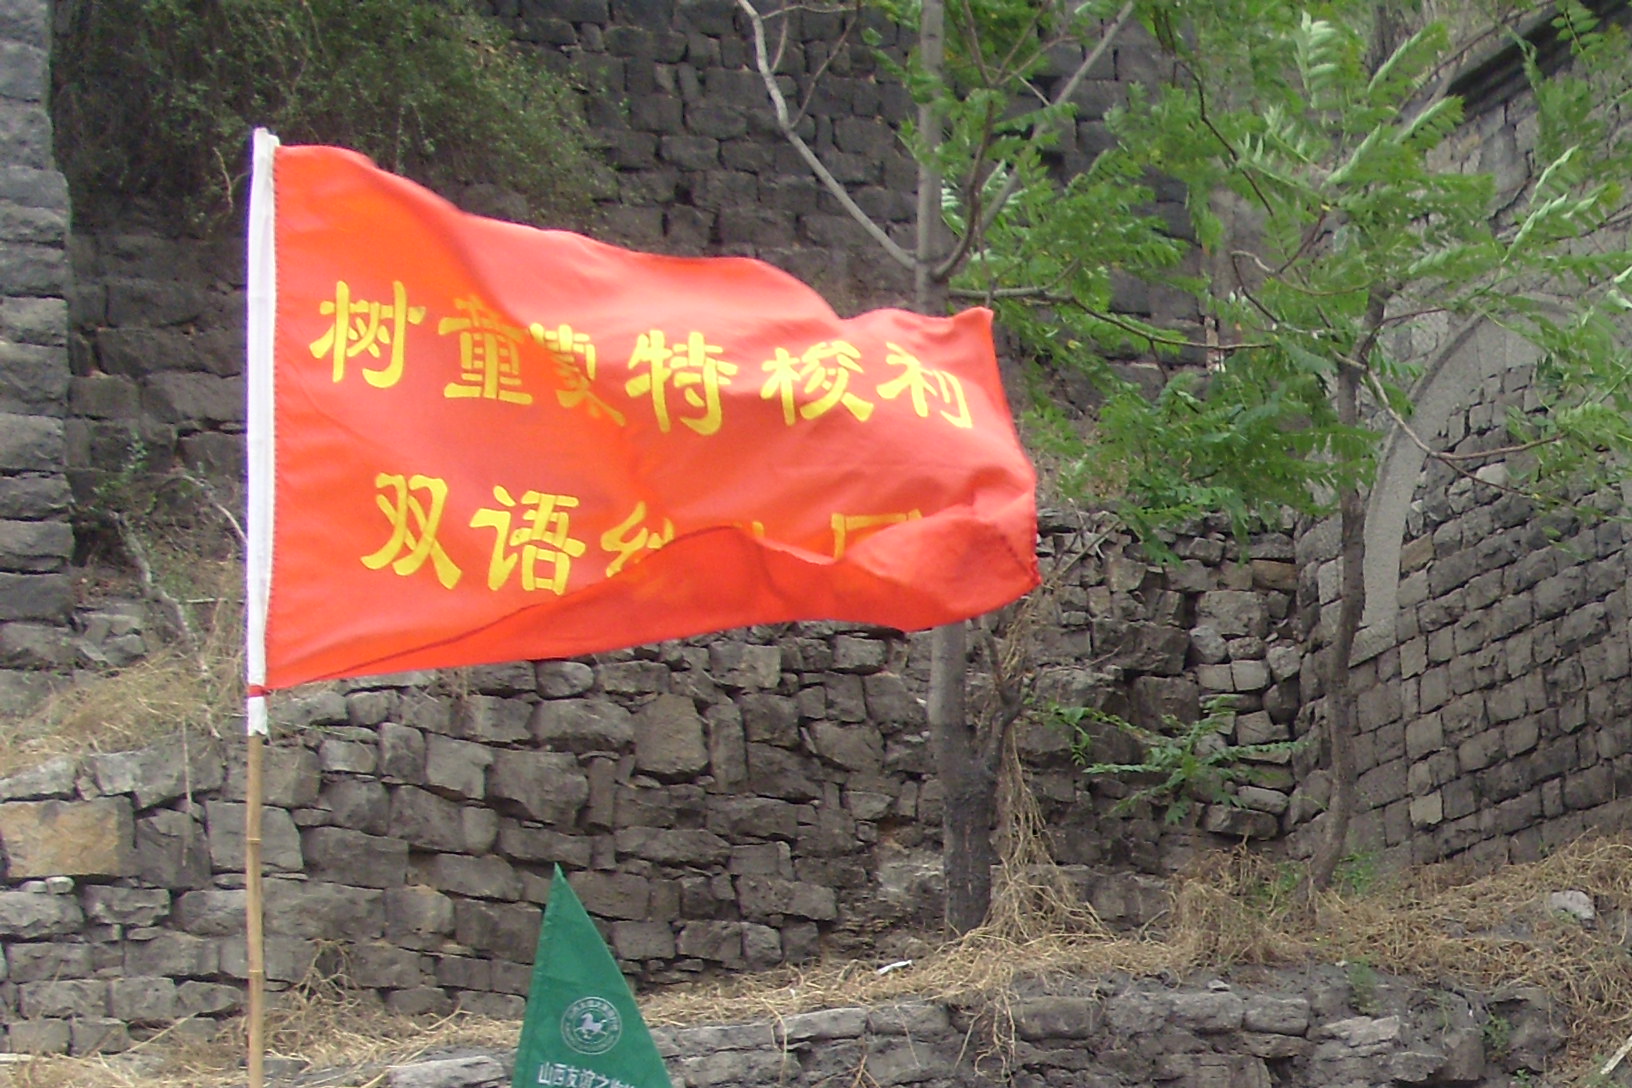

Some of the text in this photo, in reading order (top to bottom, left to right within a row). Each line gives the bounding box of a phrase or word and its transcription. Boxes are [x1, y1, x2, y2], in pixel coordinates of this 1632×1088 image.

[309, 280, 973, 436] 树童蒙特梭利
